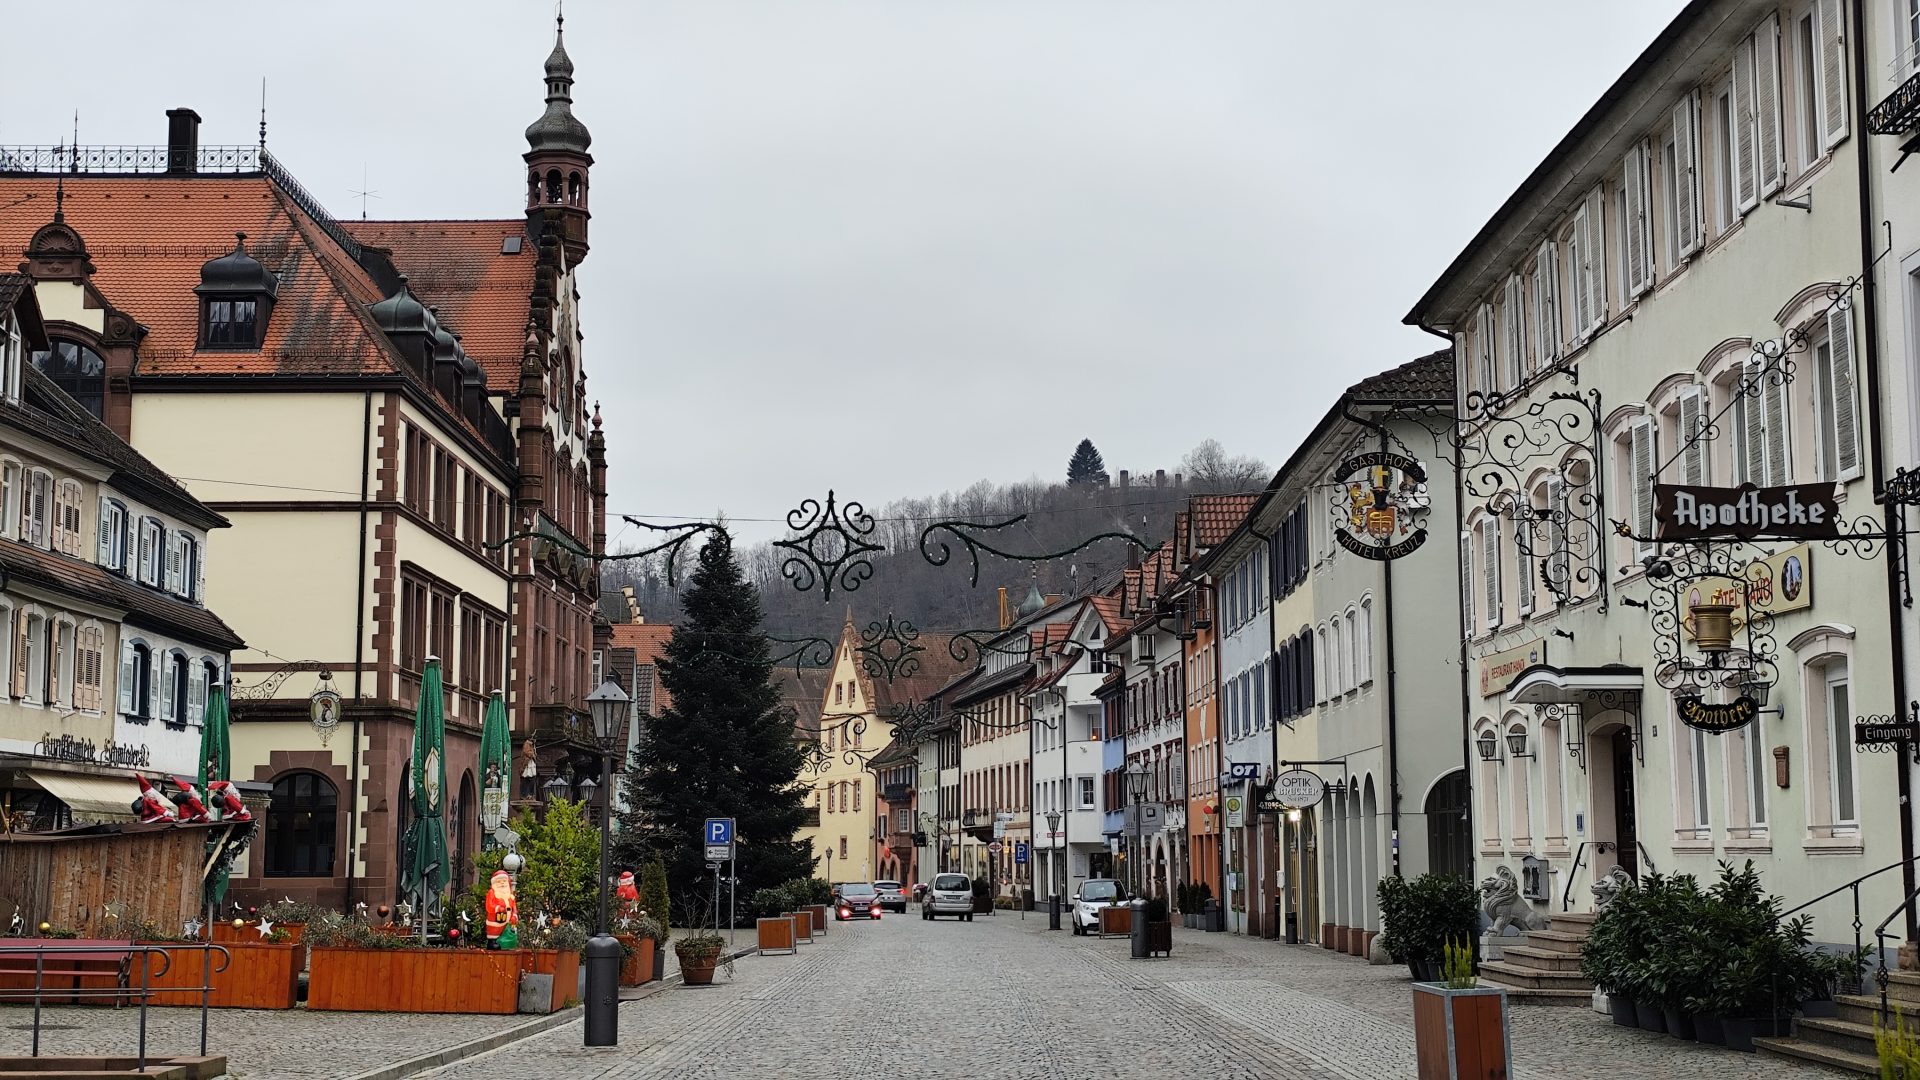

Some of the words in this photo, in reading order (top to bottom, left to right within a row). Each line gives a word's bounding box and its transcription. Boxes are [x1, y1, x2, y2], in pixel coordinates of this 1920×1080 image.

[1349, 453, 1410, 471] GASTHOF
[1673, 489, 1826, 531] Apotheke
[1341, 535, 1380, 559] HOTEL
[1384, 535, 1422, 559] KREUZ
[1865, 727, 1911, 740] Eingang
[1282, 777, 1311, 787] OPTIK
[712, 823, 725, 841] P
[1017, 845, 1025, 857] P
